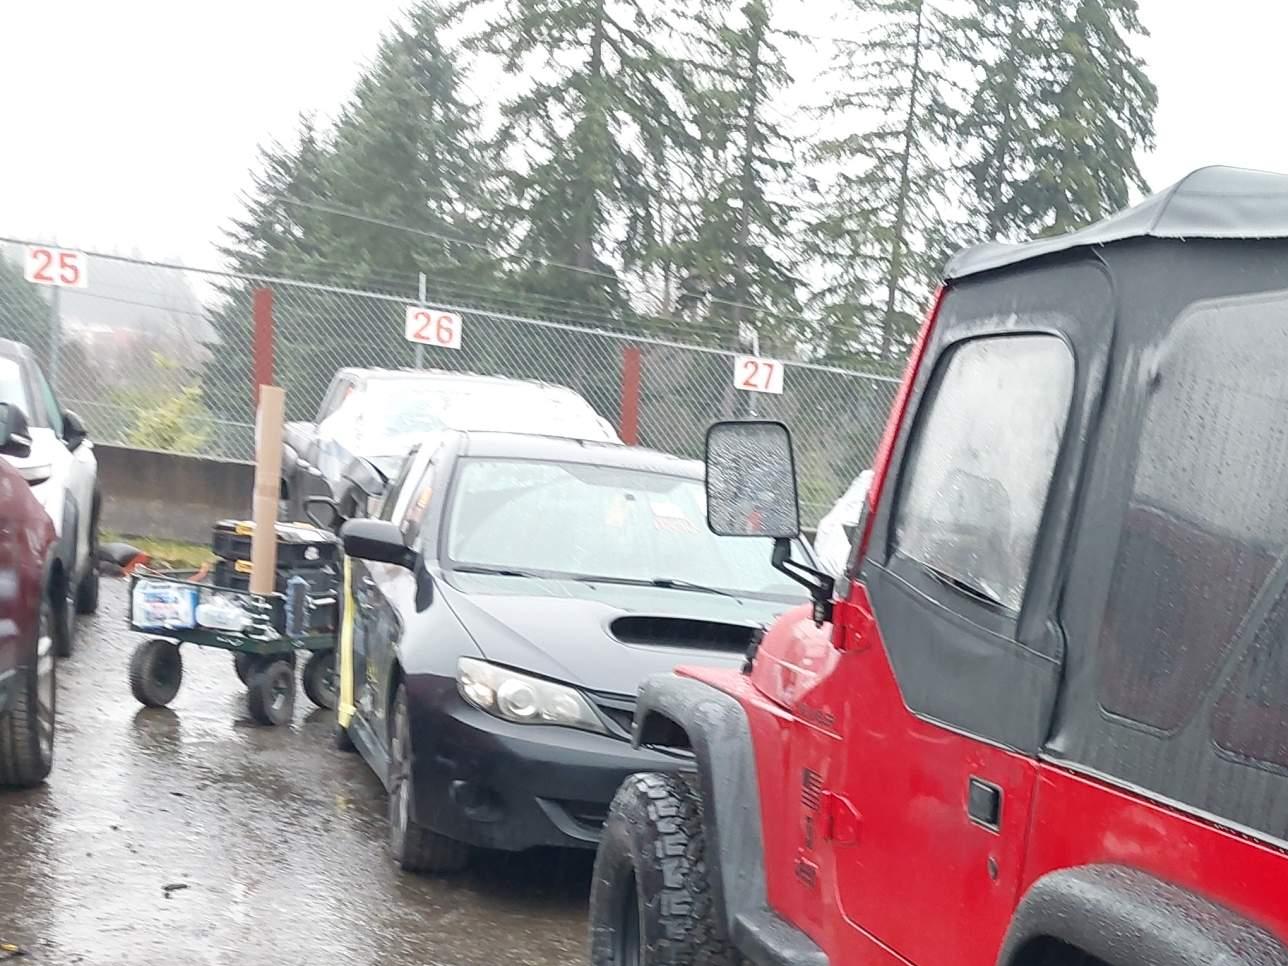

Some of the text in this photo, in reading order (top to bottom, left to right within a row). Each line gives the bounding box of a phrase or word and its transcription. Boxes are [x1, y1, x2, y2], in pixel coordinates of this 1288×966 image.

[31, 249, 80, 284] 25
[413, 311, 453, 344] 26
[742, 360, 774, 390] 27
